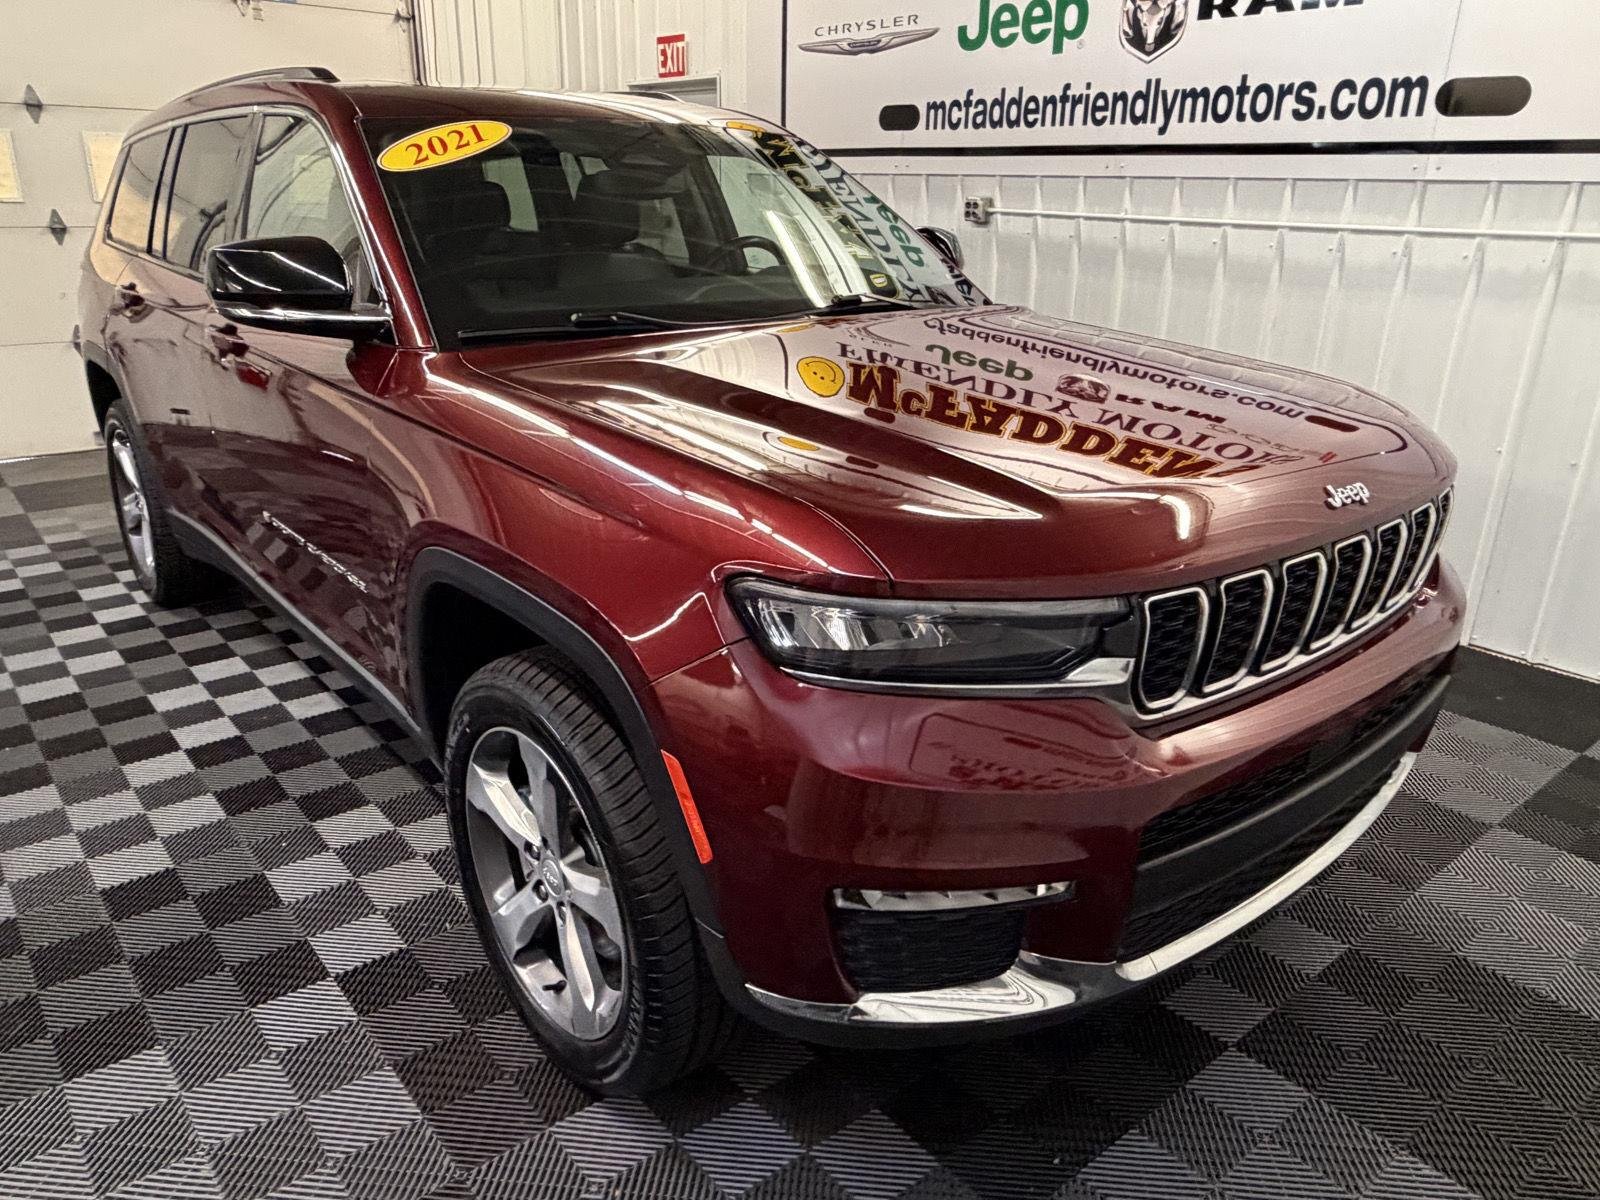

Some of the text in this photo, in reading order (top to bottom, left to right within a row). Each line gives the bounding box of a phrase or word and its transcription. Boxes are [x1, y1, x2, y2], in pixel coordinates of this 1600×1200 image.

[814, 14, 919, 37] CHRYSLER
[957, 0, 1089, 55] Jeep
[657, 42, 686, 73] EXIT
[925, 74, 1429, 136] mcfaddenfriendlymotors.com
[405, 124, 488, 165] 2021
[1325, 482, 1370, 508] Jeep
